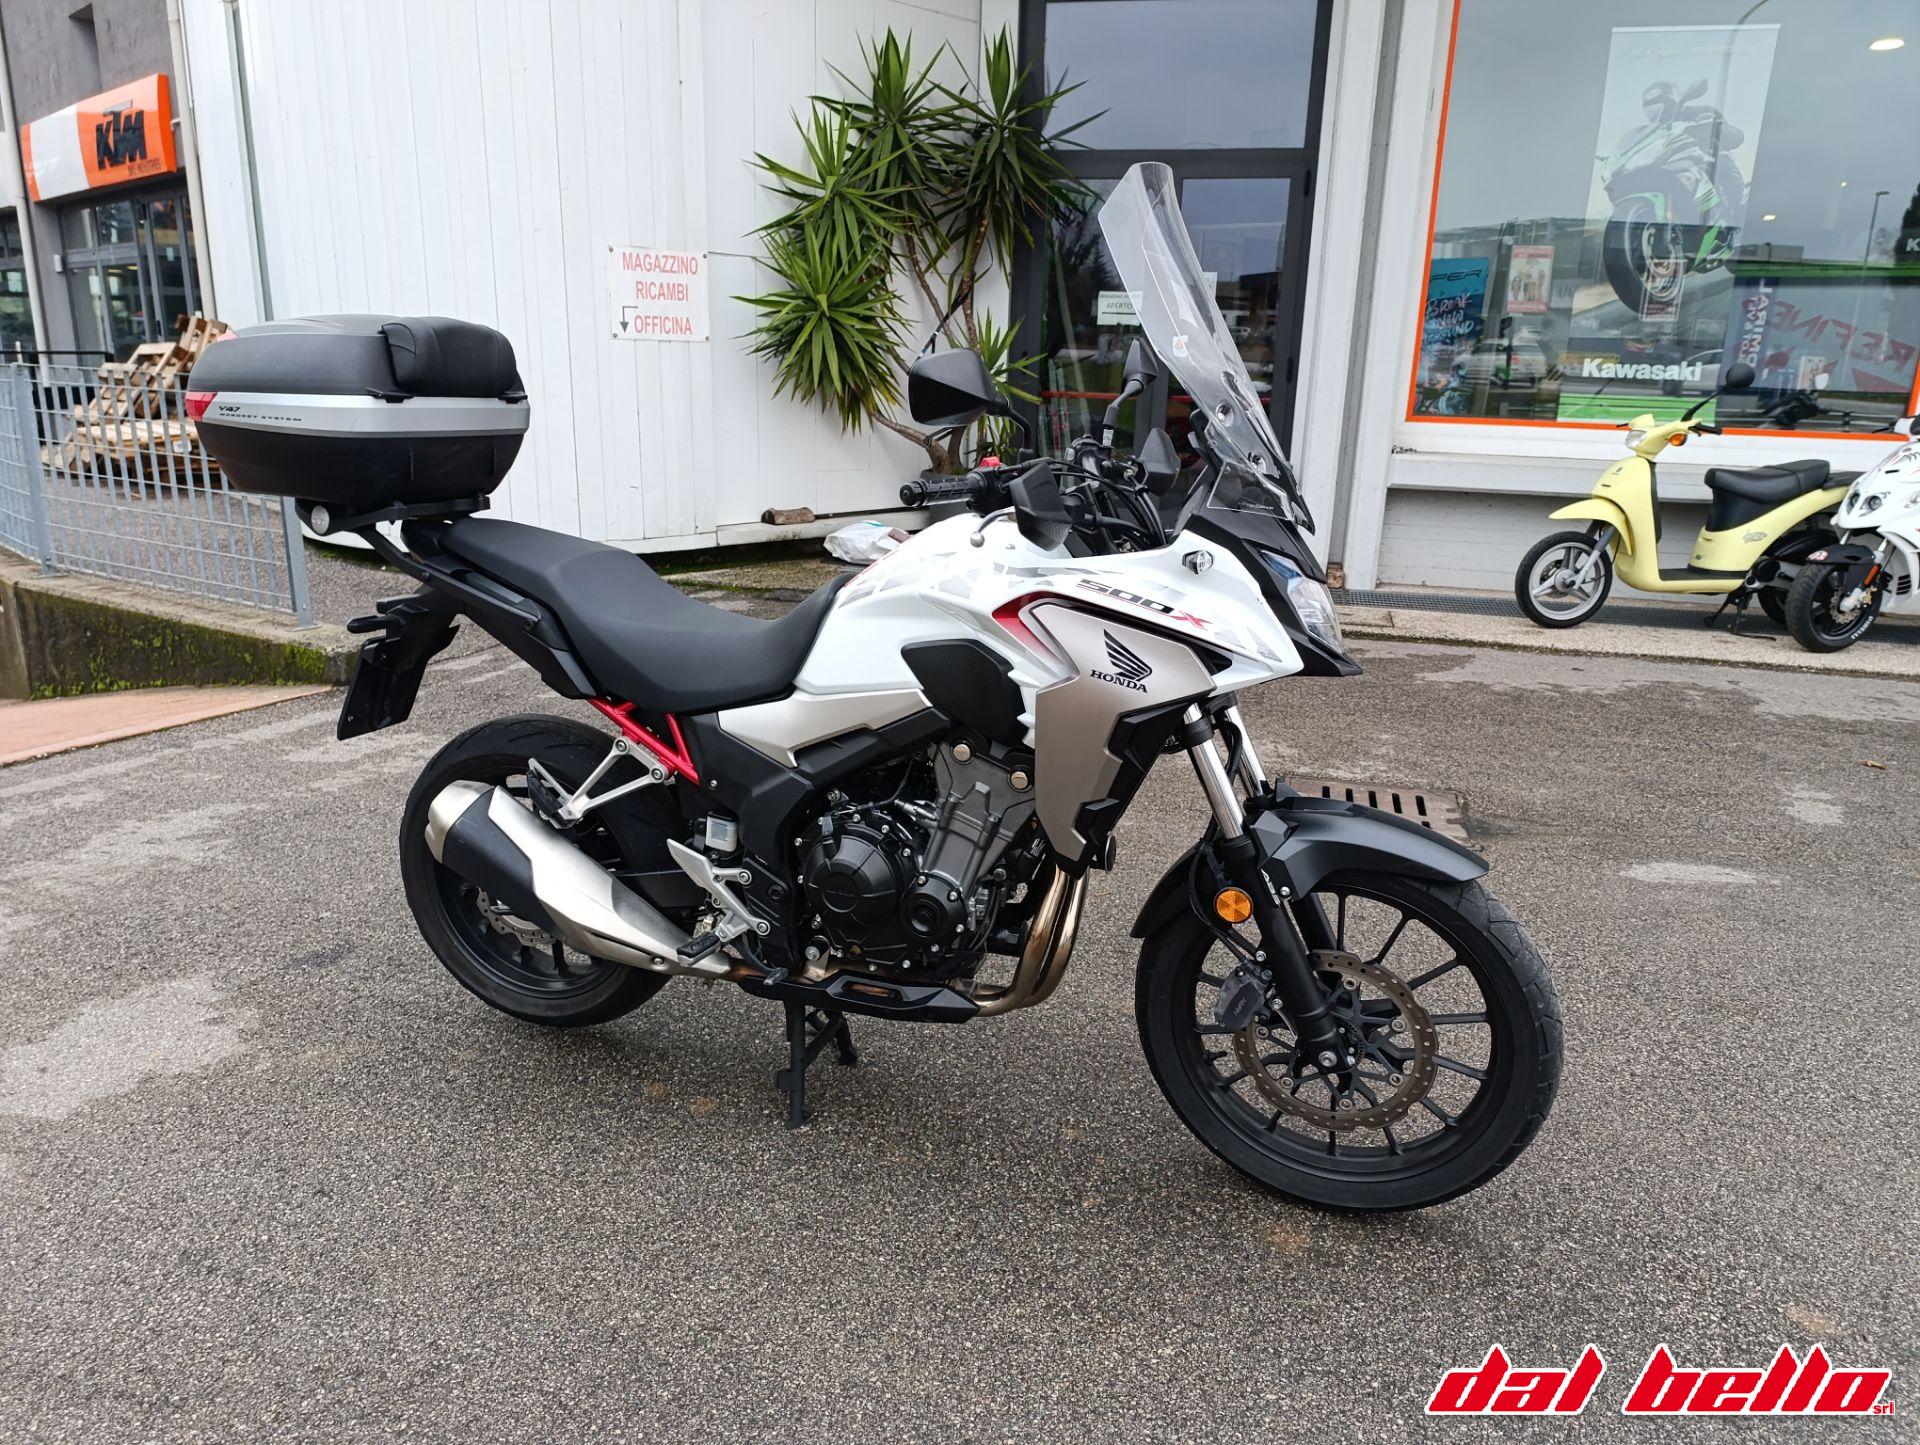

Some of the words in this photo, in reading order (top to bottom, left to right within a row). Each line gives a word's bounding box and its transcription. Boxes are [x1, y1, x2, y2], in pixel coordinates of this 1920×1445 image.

[96, 99, 147, 171] KTM
[622, 252, 699, 275] MAGAZZINO
[635, 281, 689, 301] RICAMBI
[1105, 301, 1133, 310] APERTO
[1426, 293, 1473, 317] BREAK
[634, 315, 693, 335] OFFICINA
[1437, 310, 1464, 328] NEW
[1582, 358, 1703, 381] Kawasaki
[1076, 578, 1213, 631] 500X
[1090, 669, 1148, 694] HONDA
